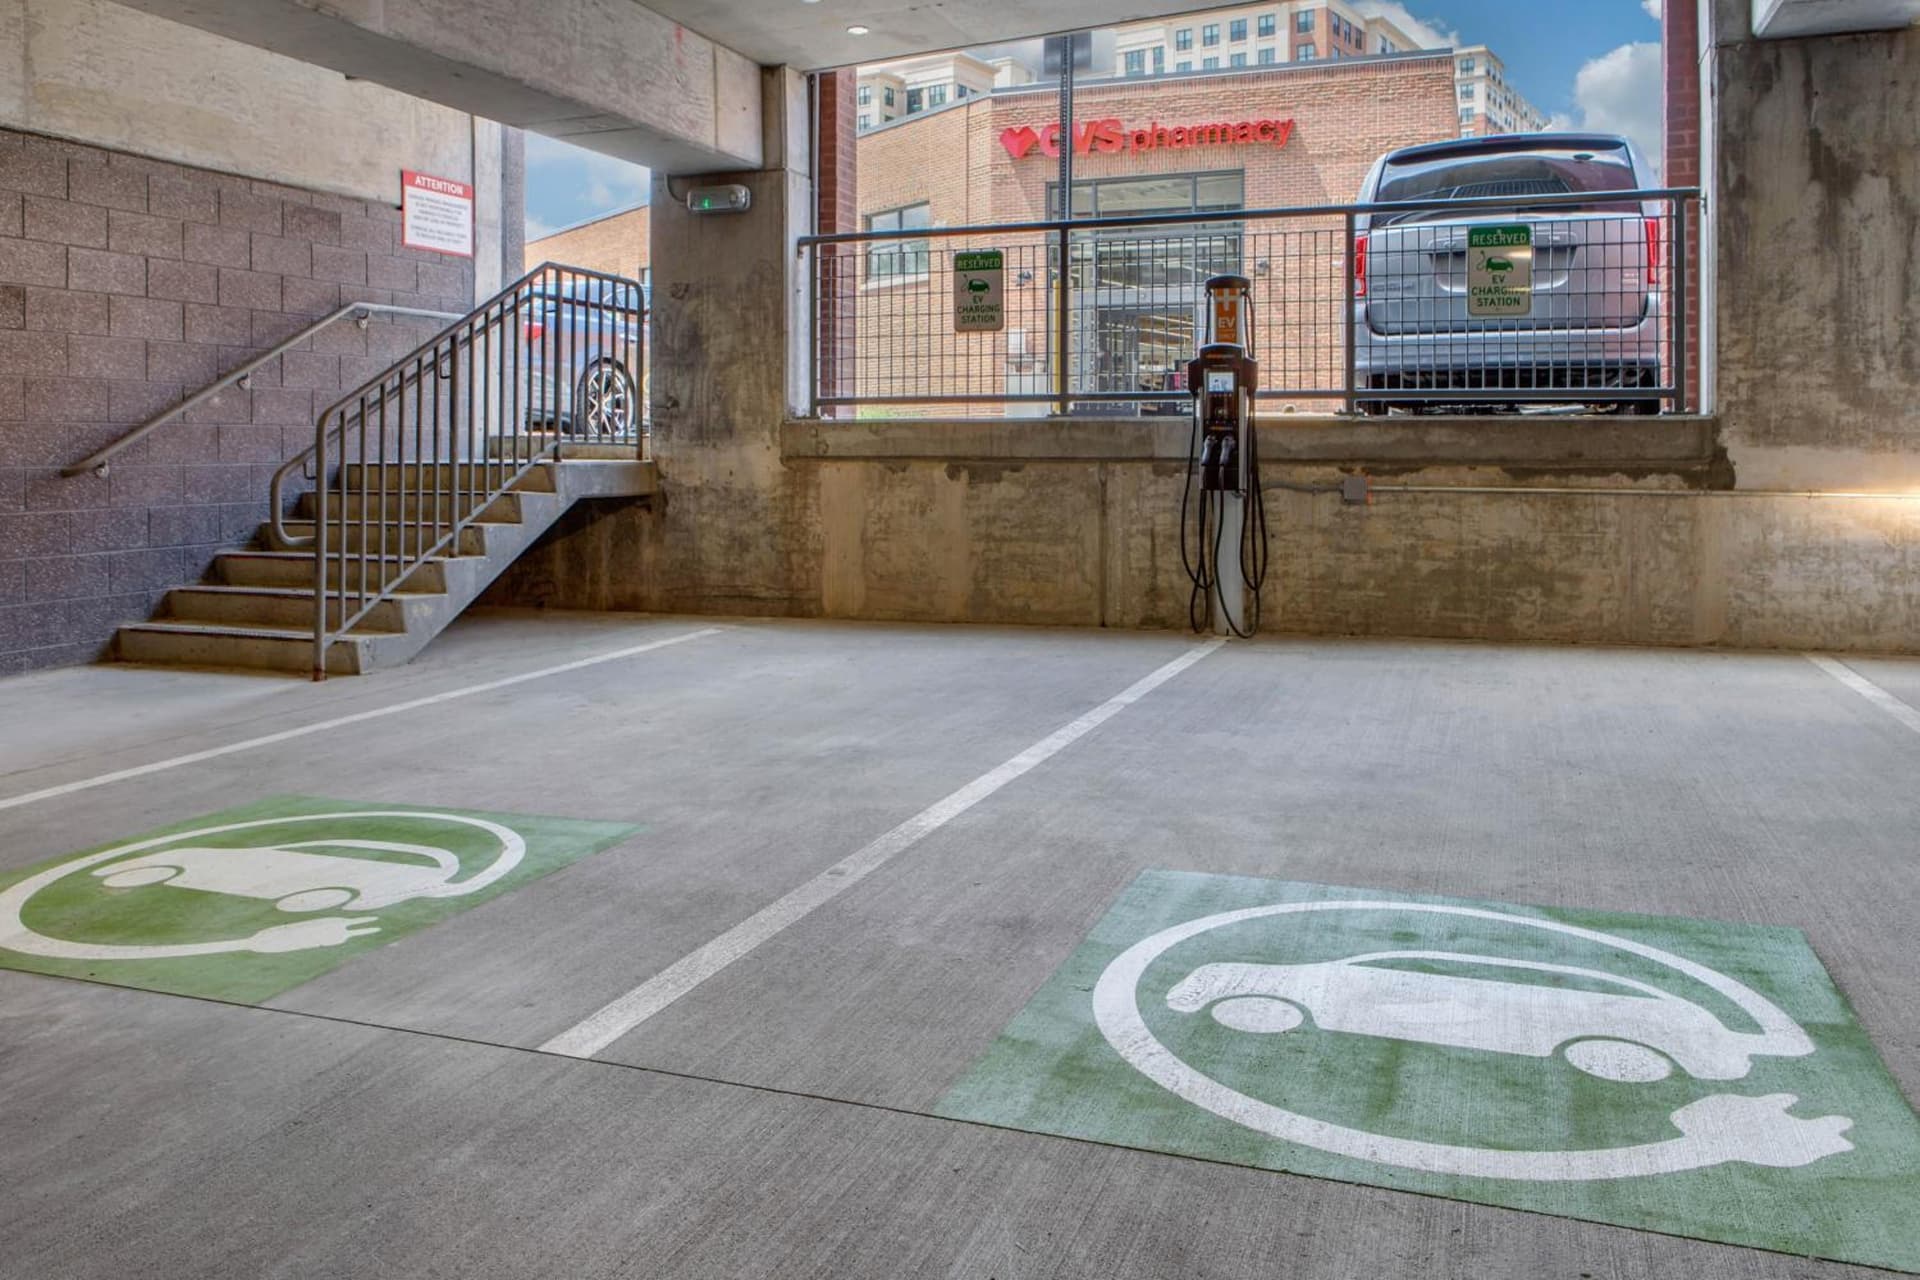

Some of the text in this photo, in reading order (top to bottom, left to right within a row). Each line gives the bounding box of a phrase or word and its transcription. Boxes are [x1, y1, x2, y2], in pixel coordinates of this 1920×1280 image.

[1039, 118, 1294, 158] CVS pharmacy
[415, 175, 464, 195] ATTENTION
[1472, 233, 1527, 246] RESERVED
[959, 258, 1000, 269] RESERVED
[1492, 274, 1506, 284] EV
[1472, 286, 1527, 296] CHARGING
[973, 295, 983, 304] EV
[1477, 297, 1520, 307] STATION
[957, 304, 1000, 314] CHARGING
[961, 314, 995, 323] STATION
[1218, 317, 1235, 328] EV
